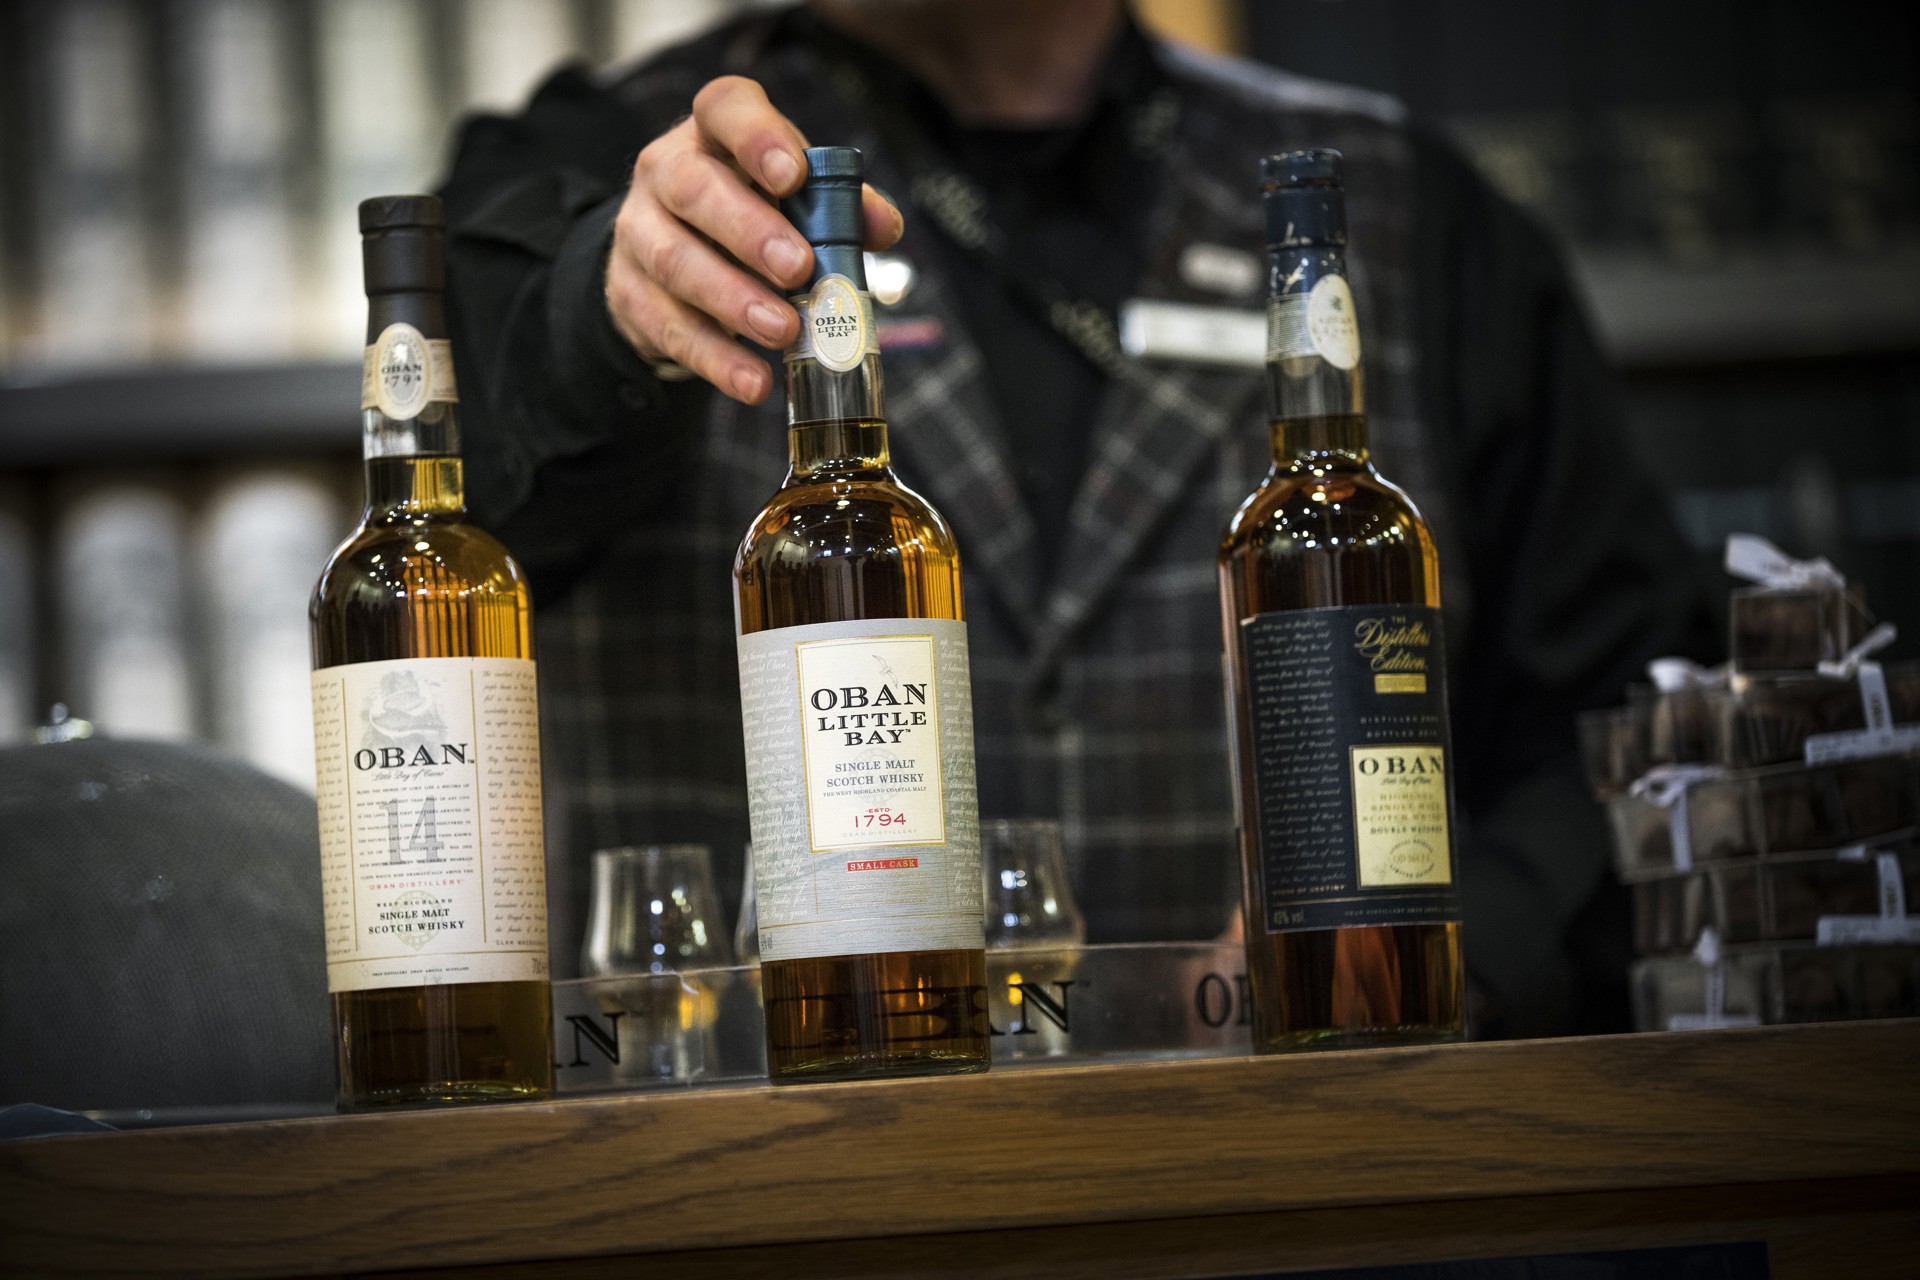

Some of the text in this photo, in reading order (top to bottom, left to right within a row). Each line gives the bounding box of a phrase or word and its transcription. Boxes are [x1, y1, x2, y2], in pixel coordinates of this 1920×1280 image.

[815, 316, 857, 326] OBAN
[817, 325, 857, 333] LITTLE
[381, 363, 422, 375] OBAN
[811, 684, 927, 711] OBAN
[817, 711, 927, 731] LITTLE
[835, 760, 915, 773] SINGLE MALT
[1359, 755, 1443, 776] OBAN
[826, 774, 924, 788] SCOTCH WHISKY
[855, 813, 906, 828] 1794
[379, 795, 444, 865] 14
[850, 859, 916, 871] SMALL CASK
[404, 898, 453, 906] HIGHLAND
[380, 908, 450, 921] SINGLE MALT
[368, 921, 465, 935] SCOTCH WHISKY
